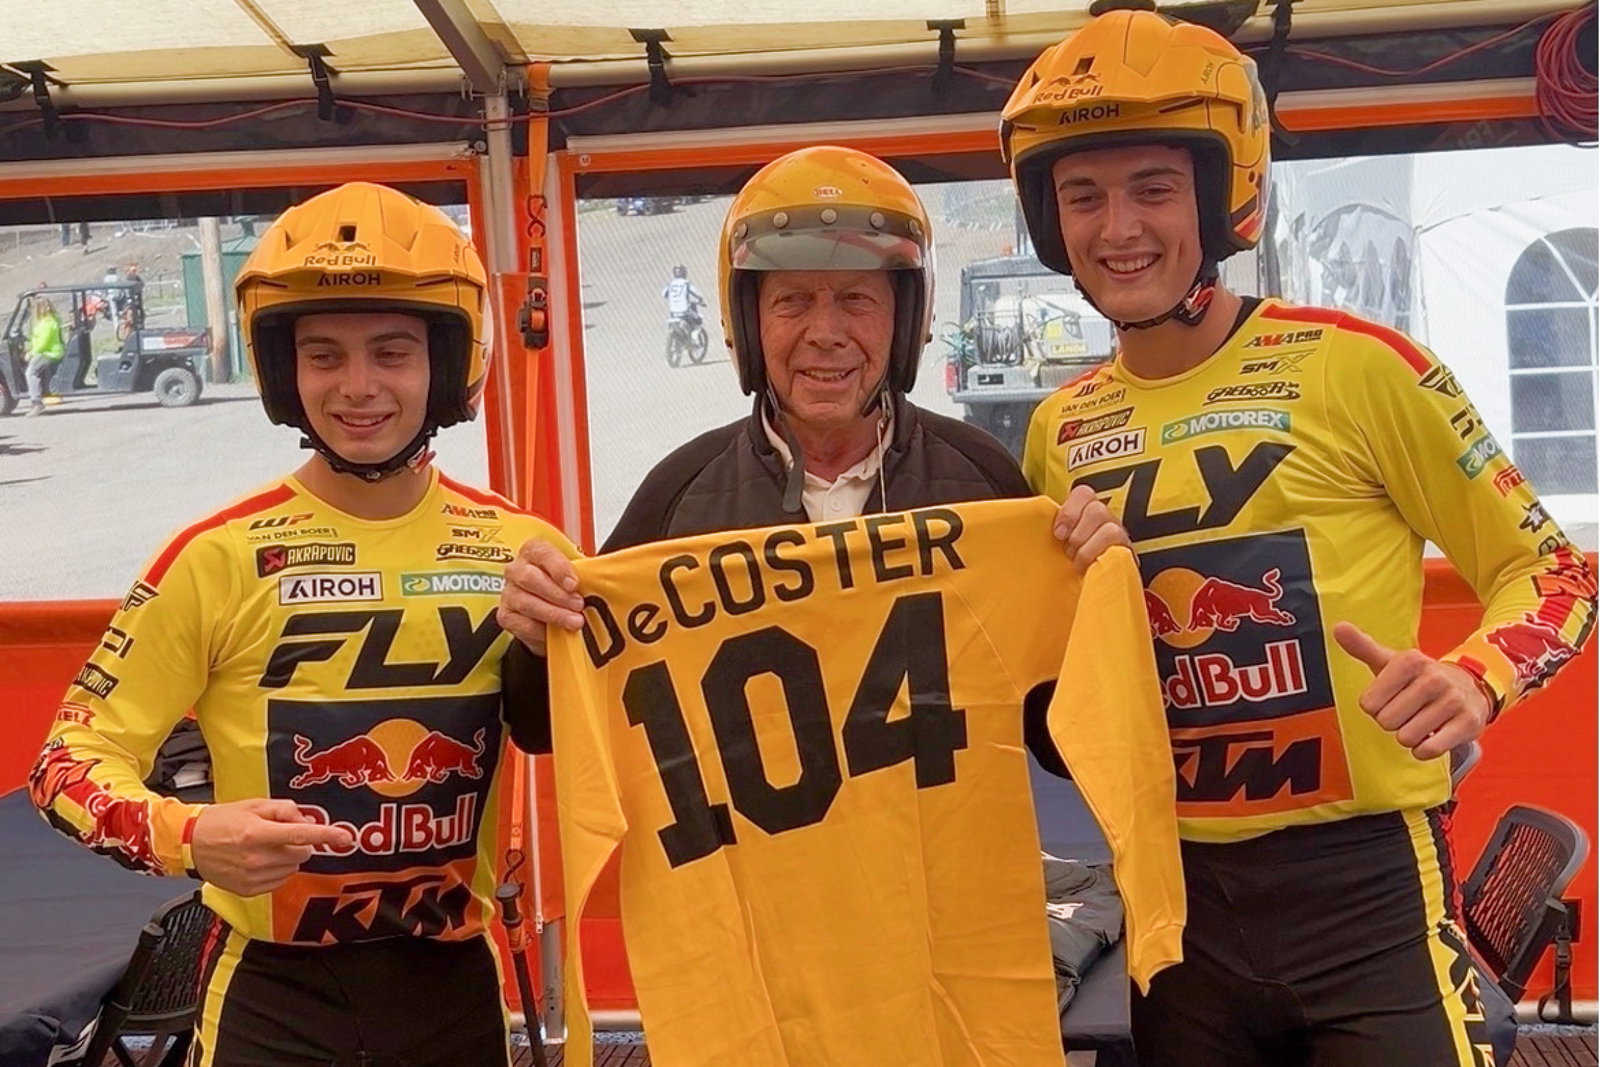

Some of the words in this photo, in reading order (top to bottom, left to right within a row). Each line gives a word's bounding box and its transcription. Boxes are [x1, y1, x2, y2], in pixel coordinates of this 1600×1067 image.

[1059, 104, 1120, 125] AIROH
[304, 256, 339, 266] Red
[342, 255, 376, 266] Bull
[317, 273, 381, 287] AIROH
[1189, 410, 1284, 435] MOTOREX
[1071, 433, 1139, 466] AIROH
[246, 534, 271, 542] VAN
[274, 530, 297, 539] DEN
[300, 527, 330, 536] BOER
[287, 545, 353, 566] AKRAPOVIC
[288, 577, 375, 600] AIROH
[579, 507, 965, 669] DeCOSTER
[258, 608, 502, 690] FLY
[1194, 639, 1308, 706] Bull
[621, 591, 968, 869] 104
[399, 792, 477, 853] Bull
[292, 875, 466, 944] KTM
